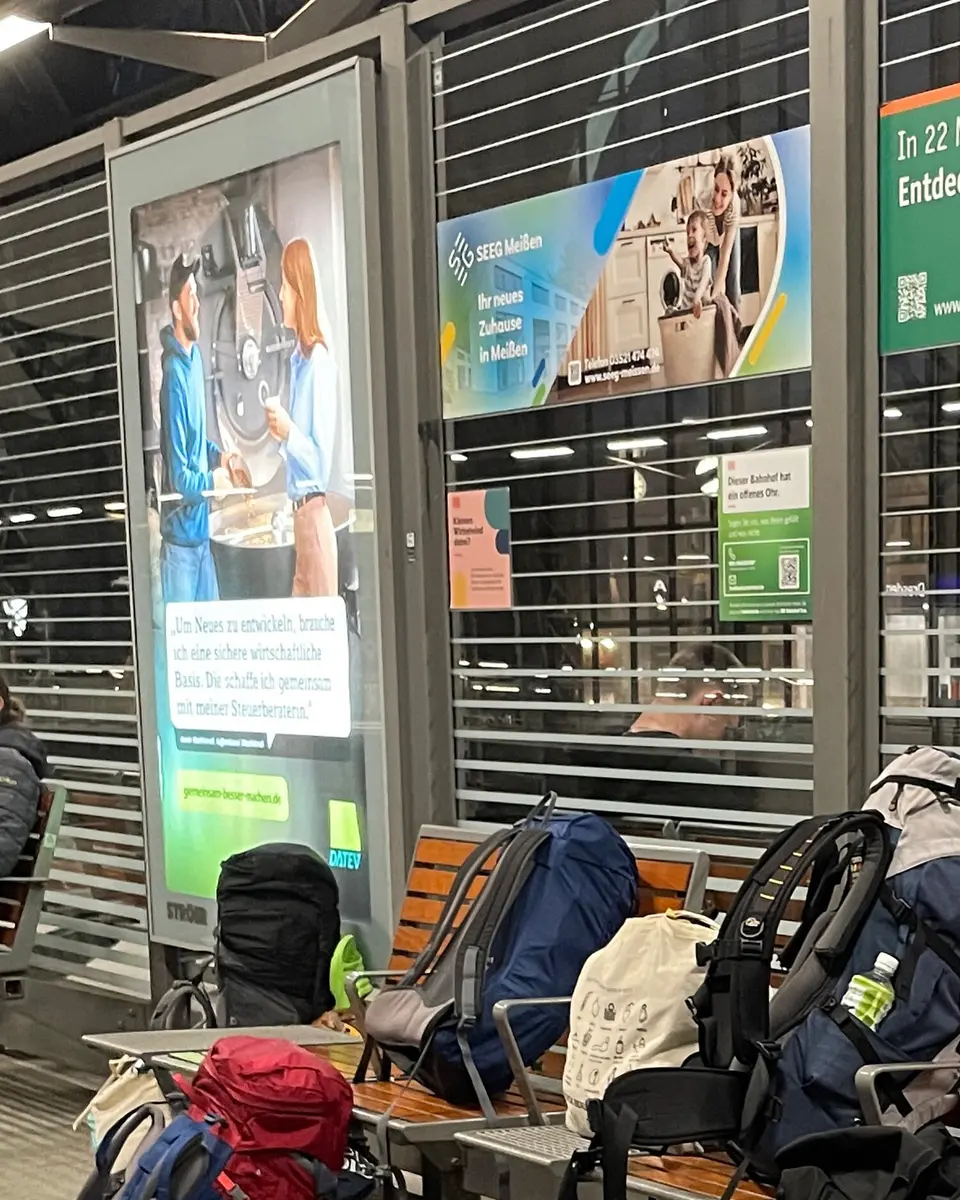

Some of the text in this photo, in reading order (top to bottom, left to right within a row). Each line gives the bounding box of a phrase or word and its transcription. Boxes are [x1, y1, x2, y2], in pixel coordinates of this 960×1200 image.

[898, 129, 917, 160] In
[925, 122, 948, 154] 22
[476, 233, 543, 262] SEEG Meißen
[477, 290, 524, 310] Ihr neues
[479, 317, 523, 337] Zuhause
[479, 340, 529, 363] in Meißen
[727, 471, 792, 487] Dieser Bahnhof hat
[727, 487, 780, 501] ein offenes Ohr.
[195, 616, 224, 634] Neues
[227, 619, 238, 634] zu
[240, 614, 297, 634] entwickeln,
[298, 613, 335, 632] brauche
[173, 642, 322, 661] ich eine sichere wirtschaftliche
[174, 671, 332, 695] Basis. Die schaffe ich gemeinsam
[176, 699, 193, 716] mit
[195, 699, 229, 717] meiner
[328, 850, 362, 871] DATEV
